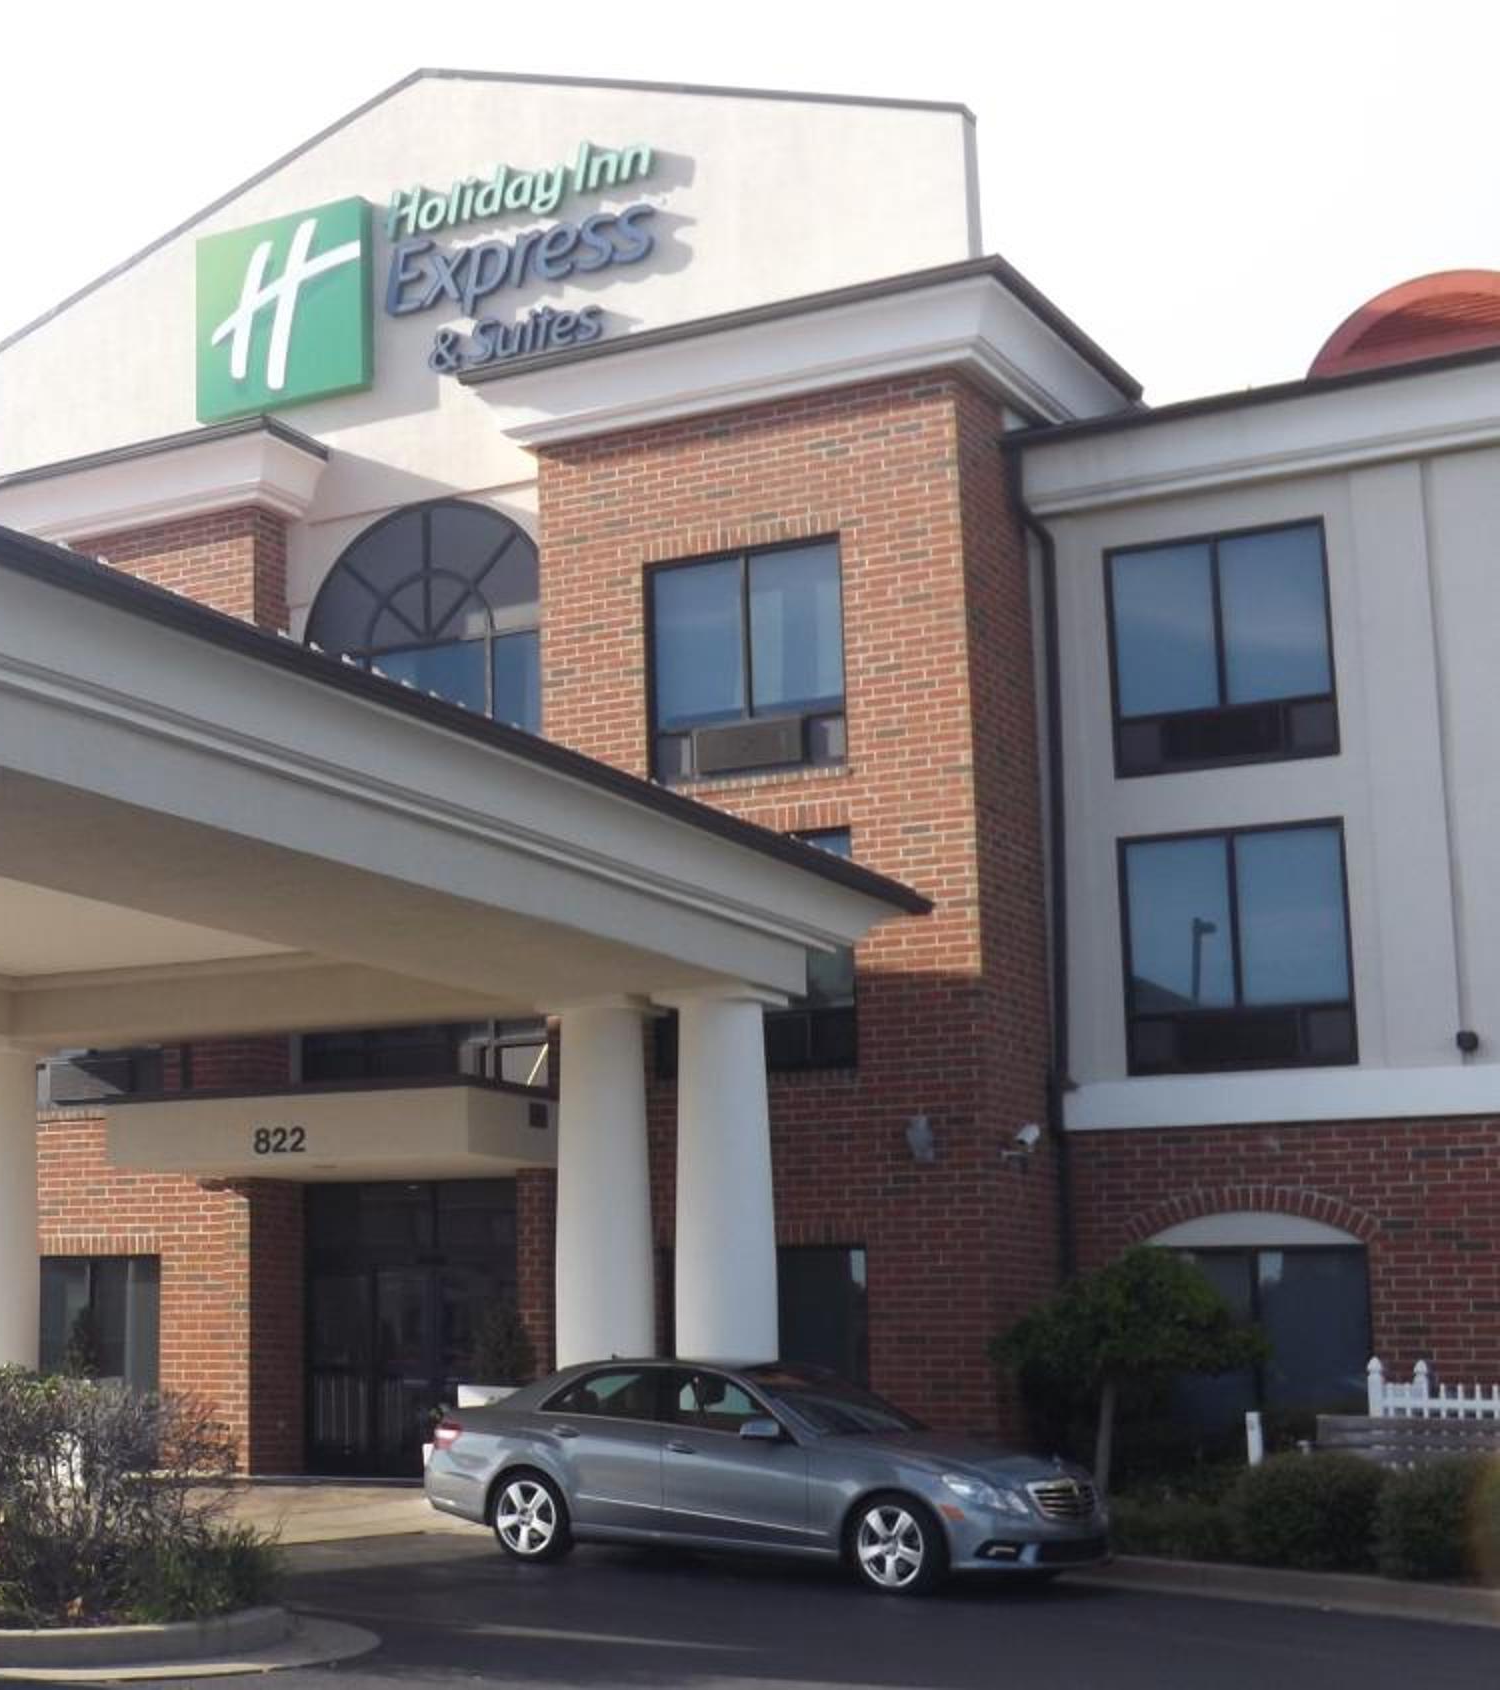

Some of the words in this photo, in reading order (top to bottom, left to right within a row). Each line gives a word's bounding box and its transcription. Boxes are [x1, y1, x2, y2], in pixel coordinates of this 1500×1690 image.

[388, 161, 565, 241] Holiday
[572, 140, 654, 194] Inn
[384, 203, 656, 318] Express
[428, 326, 462, 374] &
[462, 305, 605, 366] Suites
[254, 1126, 306, 1154] 822
